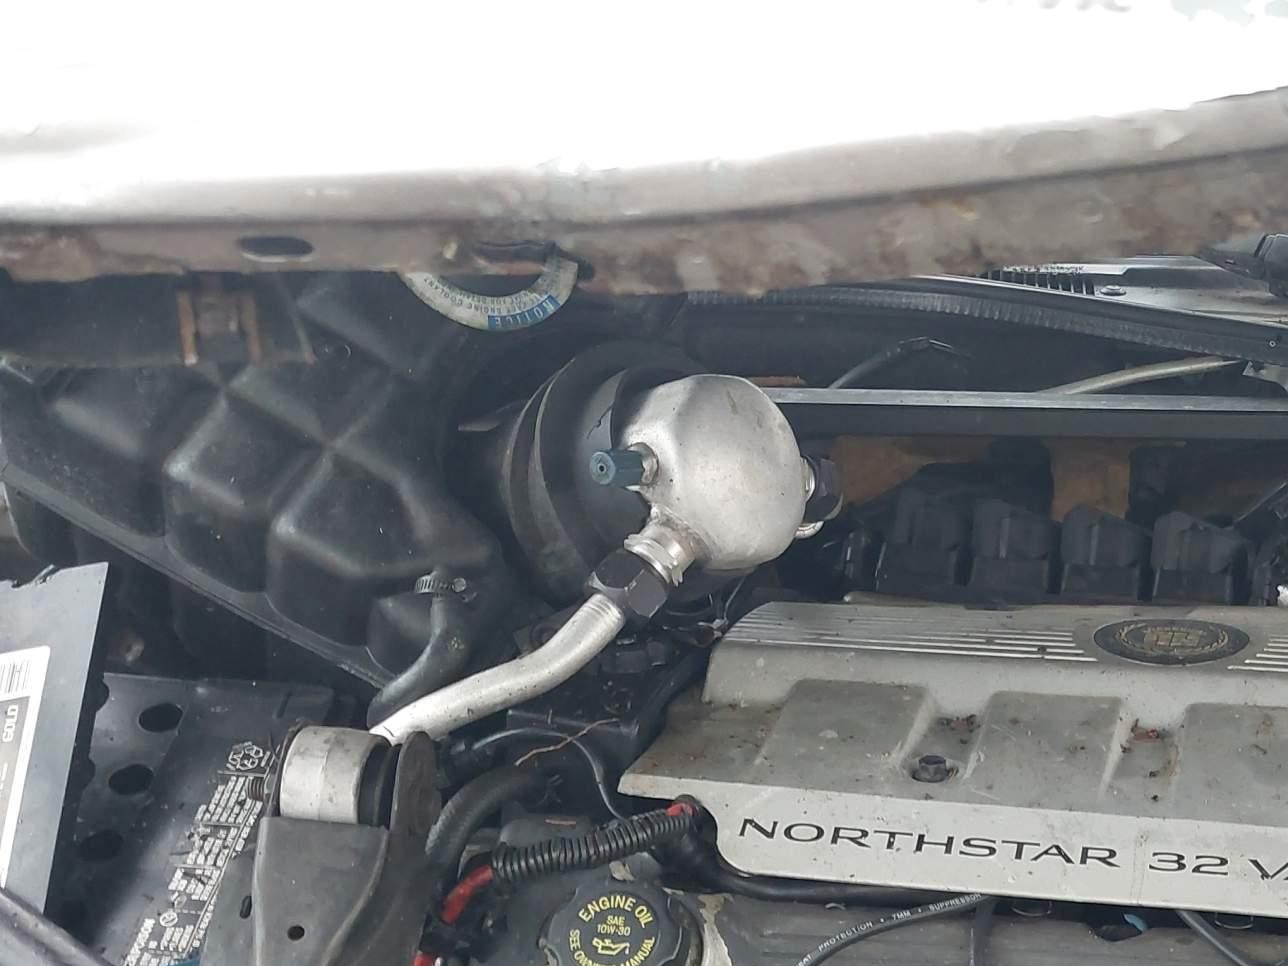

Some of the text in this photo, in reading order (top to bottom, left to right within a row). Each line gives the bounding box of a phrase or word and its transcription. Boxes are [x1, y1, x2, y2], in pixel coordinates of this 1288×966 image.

[2, 704, 18, 743] GOLD
[738, 818, 1121, 868] NORTHSTAR
[1148, 851, 1229, 876] 32
[578, 895, 654, 928] ENGINE OIL
[606, 915, 625, 926] SAE
[569, 929, 581, 951] SEE
[597, 924, 631, 936] 10W-30
[818, 921, 873, 952] PROTECTION
